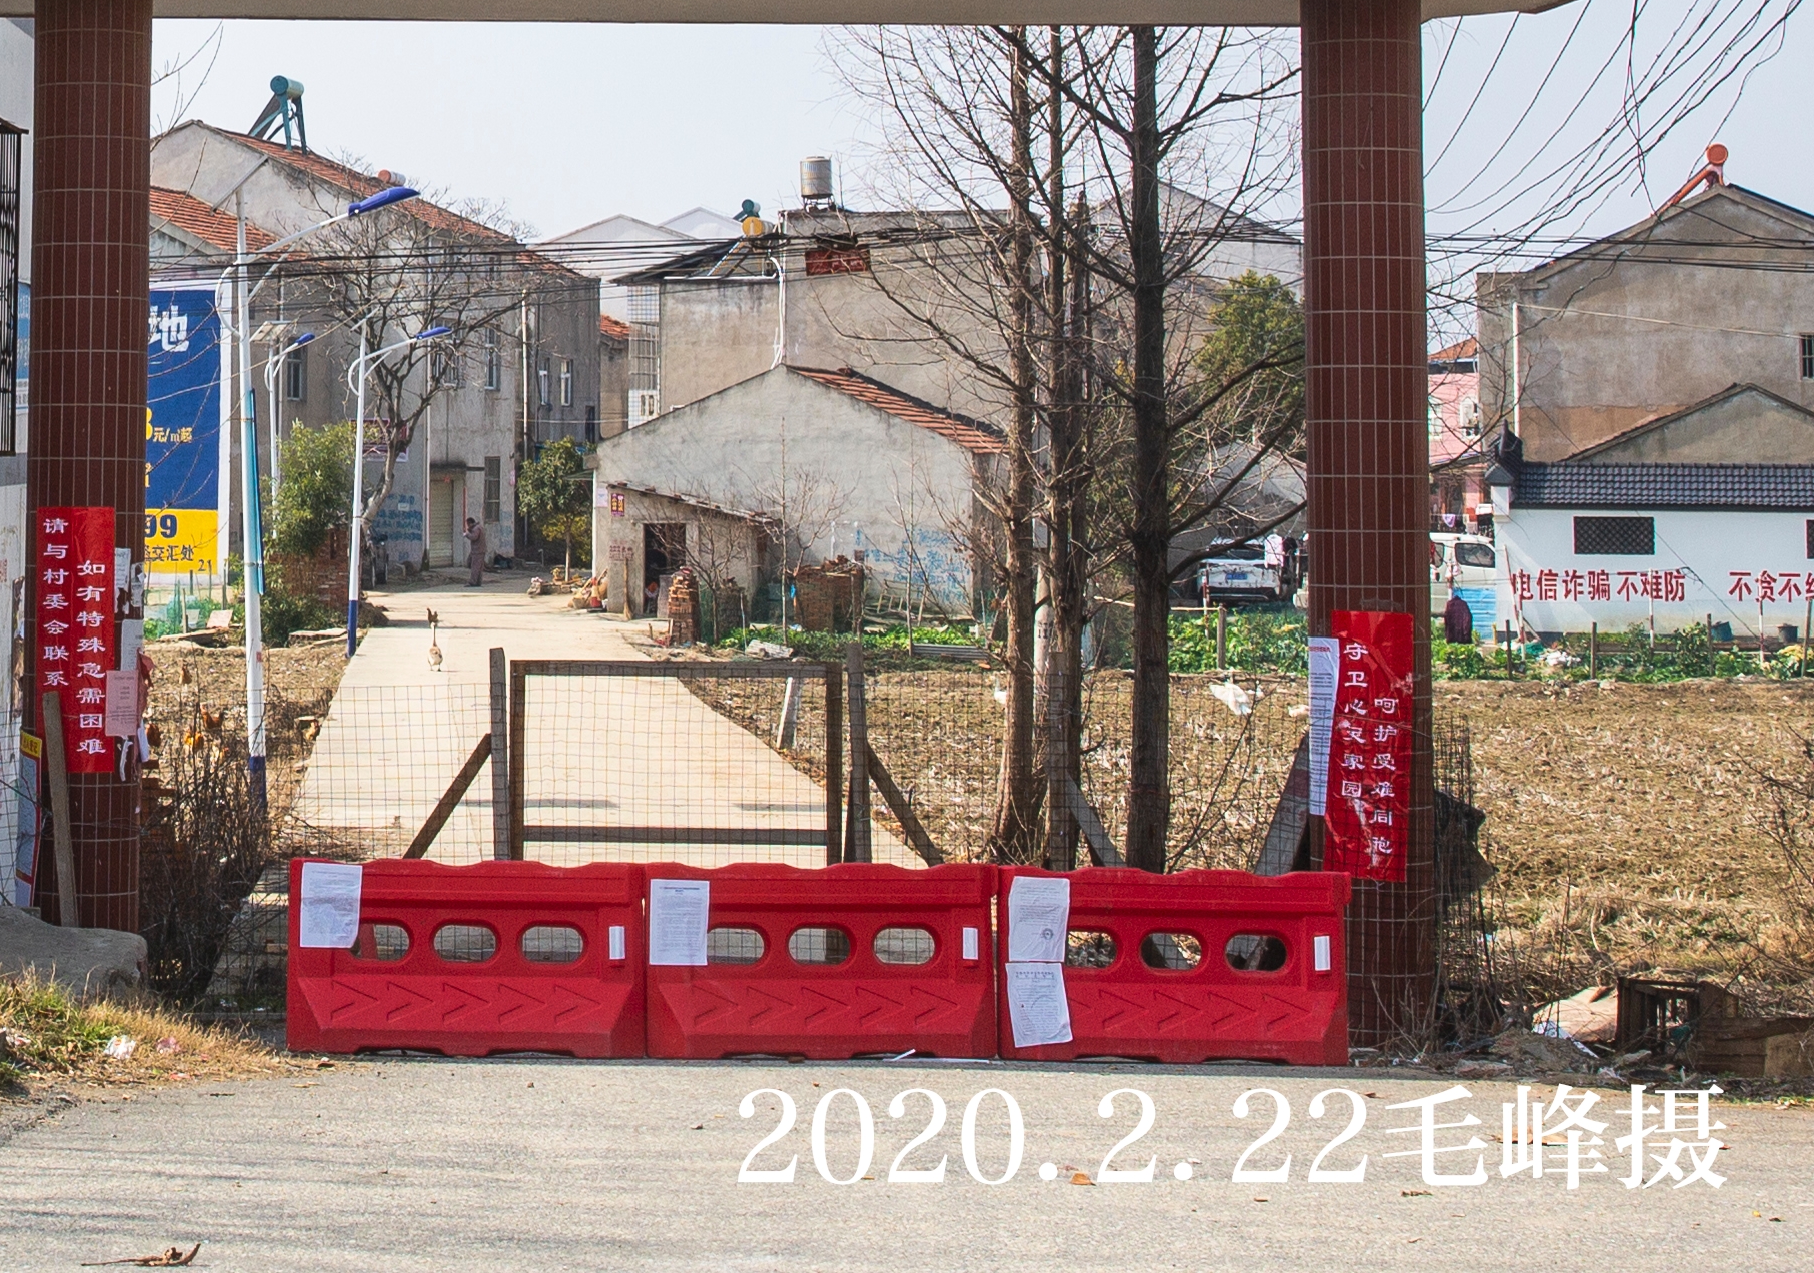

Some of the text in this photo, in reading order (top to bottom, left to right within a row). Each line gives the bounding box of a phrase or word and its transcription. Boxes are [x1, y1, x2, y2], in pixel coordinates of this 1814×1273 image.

[43, 517, 69, 687] 请与村委会联系
[76, 560, 106, 754] 如有特殊急需困难
[1370, 697, 1398, 855] 呵护受难同胞
